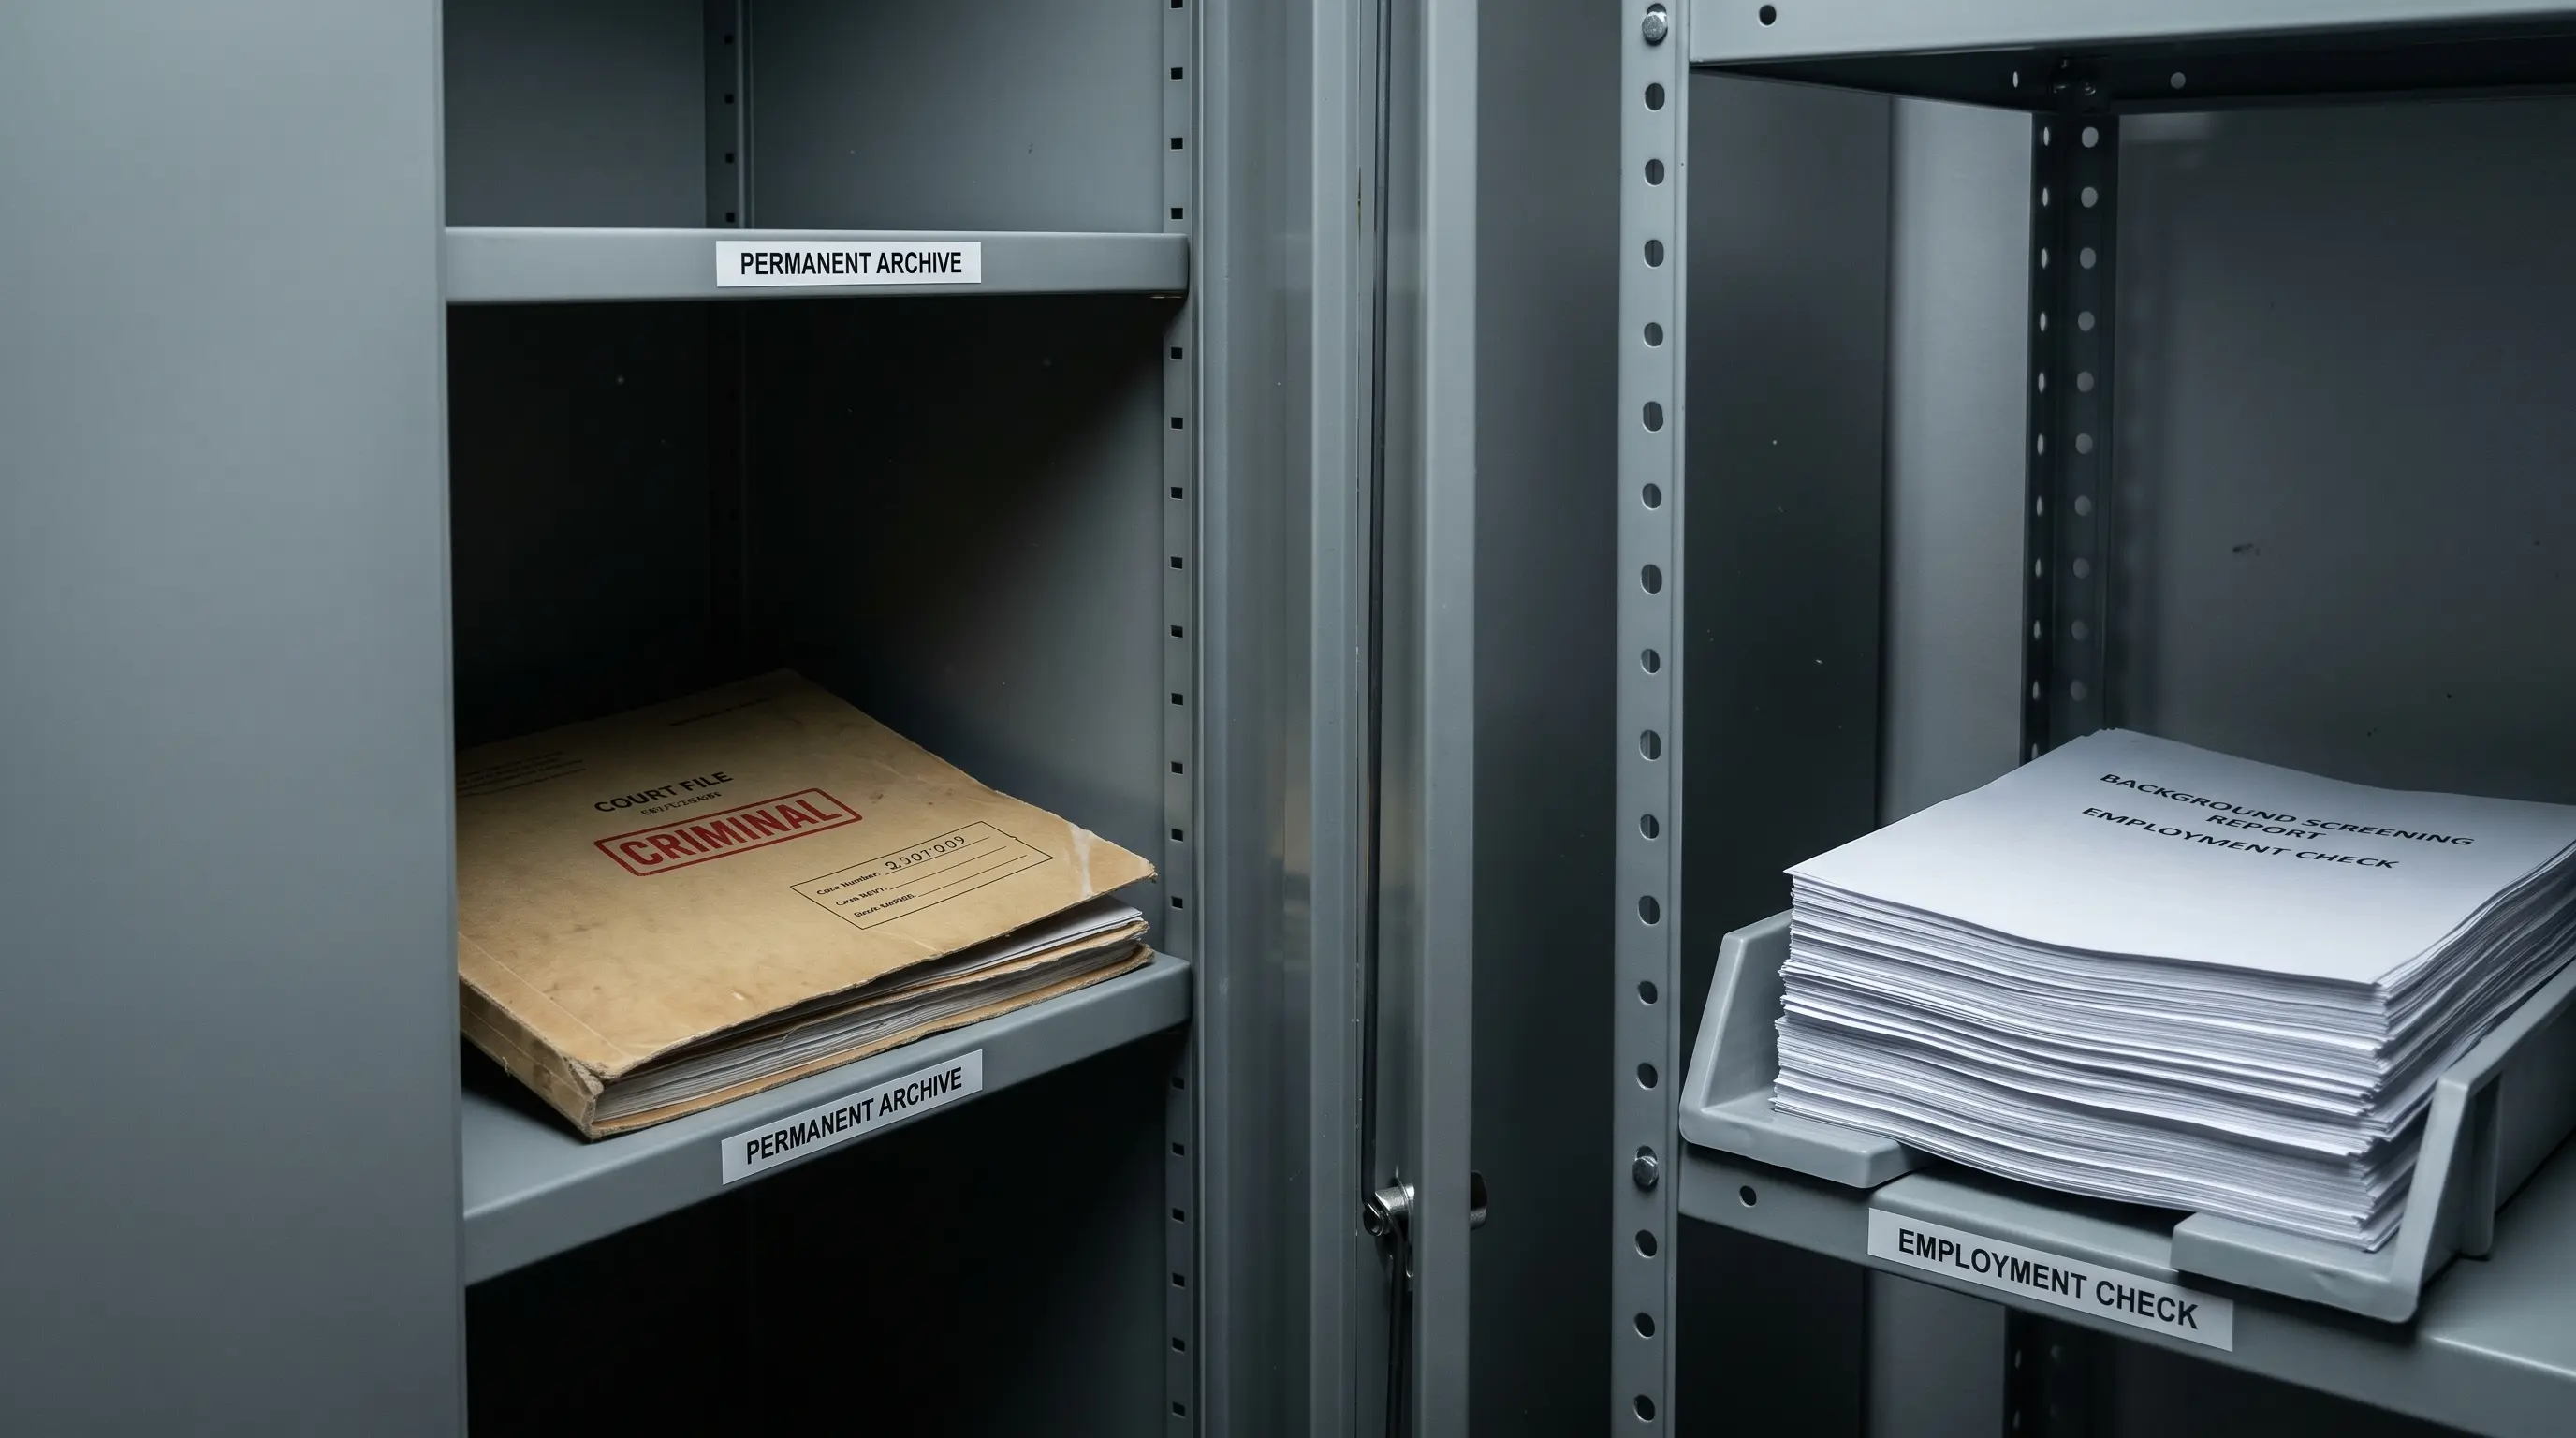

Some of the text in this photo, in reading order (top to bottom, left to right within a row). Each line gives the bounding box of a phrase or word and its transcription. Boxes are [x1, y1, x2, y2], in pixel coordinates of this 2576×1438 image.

[740, 251, 962, 275] PERMANENT ARCHIVE
[594, 785, 679, 813] COURT
[679, 771, 734, 792] FILE
[2100, 774, 2475, 845] BACKGROUND SCREENING
[619, 799, 843, 866] CRIMINAL
[2082, 807, 2399, 869] EMPLOYMENT CHECK
[2205, 814, 2327, 840] REPORT
[746, 1066, 962, 1165] PERMANENT ARCHIVE
[1898, 1228, 2198, 1329] EMPLOYMENT CHECK
